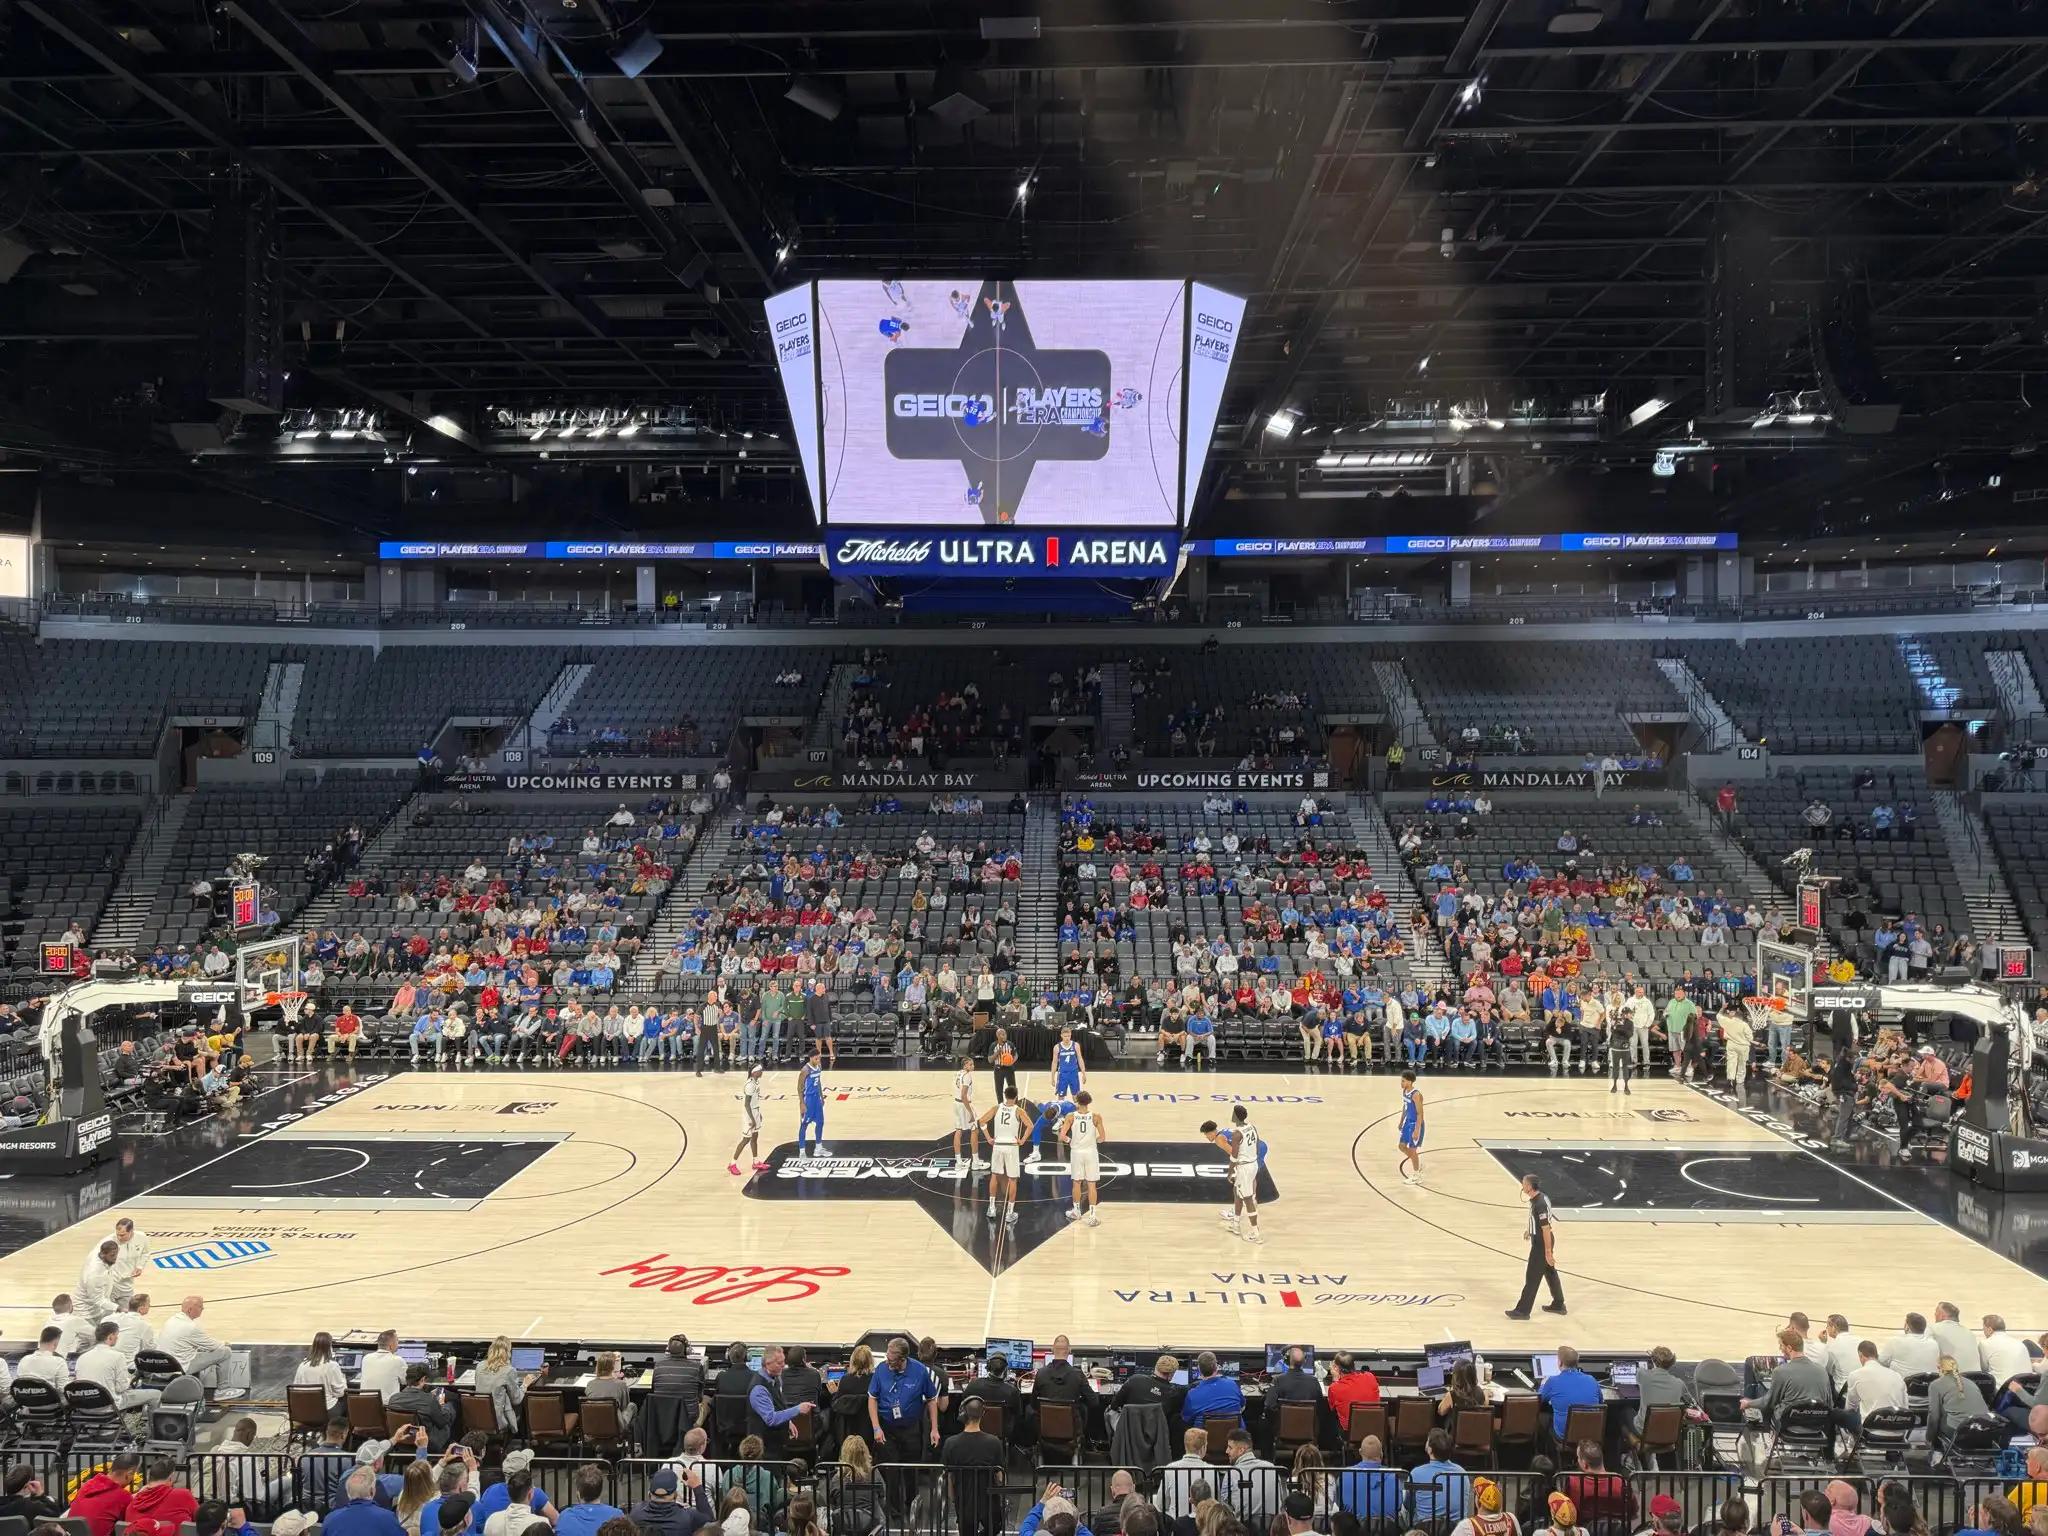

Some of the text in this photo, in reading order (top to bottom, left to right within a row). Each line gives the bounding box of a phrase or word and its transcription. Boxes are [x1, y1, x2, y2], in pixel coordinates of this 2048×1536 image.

[776, 313, 807, 332] GEICO
[1197, 313, 1233, 332] GEICO
[779, 334, 810, 352] PLAYERS
[1193, 334, 1230, 353] PLAYERS
[1278, 542, 1316, 550] PLAYERS
[1408, 540, 1444, 548] GEICO
[1451, 539, 1490, 548] PLAYERS
[1626, 537, 1665, 545] PLAYERS
[400, 546, 436, 554] GEICO
[441, 544, 478, 554] PLAYERS
[567, 546, 603, 554] GEICO
[608, 545, 646, 554] PLAYERS
[735, 546, 770, 554] GEICO
[776, 544, 813, 554] PLAYERS
[837, 539, 1167, 564] Michelob ULTRA ARENA
[1808, 612, 1825, 620] 204
[255, 753, 273, 763] 109
[505, 752, 521, 762] 108
[810, 752, 825, 761] 107
[1422, 750, 1438, 759] 105
[1741, 749, 1758, 758] 104
[506, 776, 672, 789] UPCOMING EVENTS
[842, 774, 974, 786] MANDALAY BAY
[1138, 774, 1304, 787] UPCOMING EVENTS
[1483, 773, 1626, 786] MANDALAY AY
[236, 902, 252, 923] 30
[1804, 904, 1818, 927] 30
[46, 947, 68, 956] 20:00
[49, 956, 65, 969] 30
[1814, 997, 1866, 1008] GEICO
[1065, 1055, 1070, 1063] 4
[813, 1077, 819, 1086] 2
[1113, 1092, 1200, 1104] club
[238, 1074, 389, 1137] LAS VEGAS
[1000, 1112, 1011, 1125] 12
[1685, 1081, 1828, 1149] LAS VEGAS
[77, 1114, 110, 1134] GEICO
[1080, 1121, 1086, 1133] 0
[79, 1127, 112, 1144] PLAYERS
[1246, 1131, 1256, 1146] 24
[1958, 1127, 1990, 1147] GEICO
[19, 1142, 56, 1150] RESORTS
[80, 1141, 97, 1155] ERA
[1958, 1140, 1989, 1160] PLAYERS
[776, 1167, 969, 1179] PLAYERS
[598, 1253, 852, 1305] Lilly
[1211, 1272, 1349, 1285] ARENA
[1112, 1289, 1466, 1308] Michelob ULTRA
[13, 1387, 47, 1395] PLAYERS
[66, 1388, 100, 1397] PLAYERS
[1790, 1408, 1829, 1417] PLAYERS
